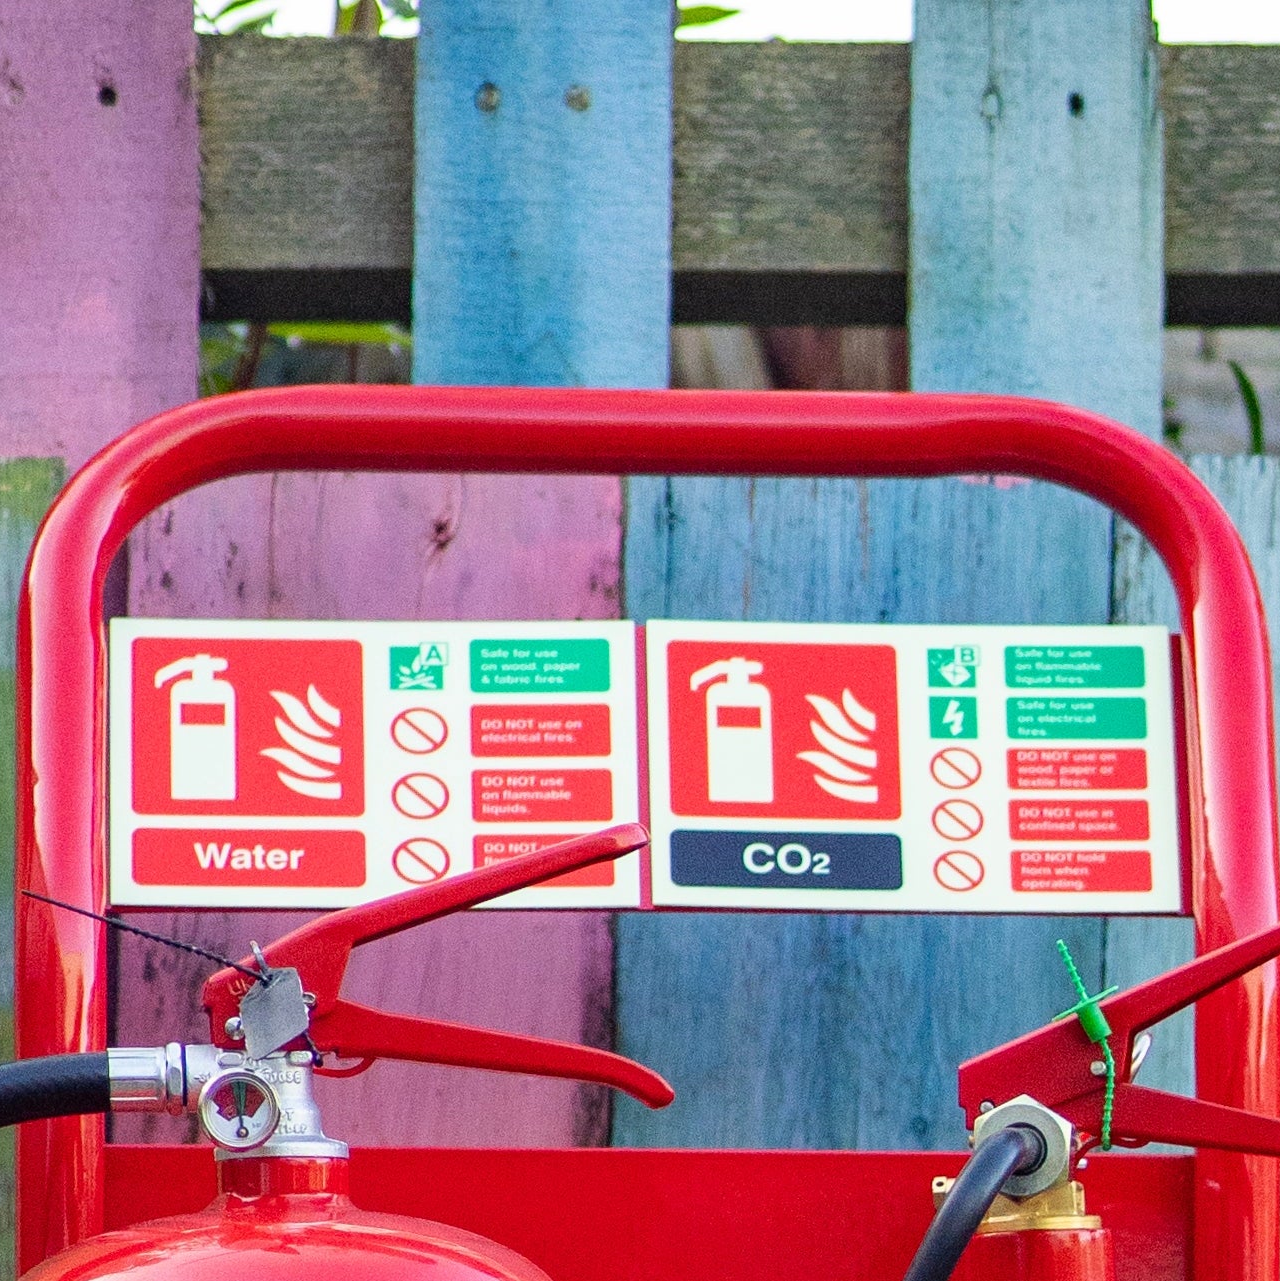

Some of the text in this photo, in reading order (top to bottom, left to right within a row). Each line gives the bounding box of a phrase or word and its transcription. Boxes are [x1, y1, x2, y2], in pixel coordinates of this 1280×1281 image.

[425, 645, 442, 663] A
[960, 648, 975, 662] B
[481, 719, 582, 730] DO NOT use on
[482, 775, 564, 787] DO NOT use
[482, 789, 571, 800] on flammable
[194, 842, 304, 870] Water
